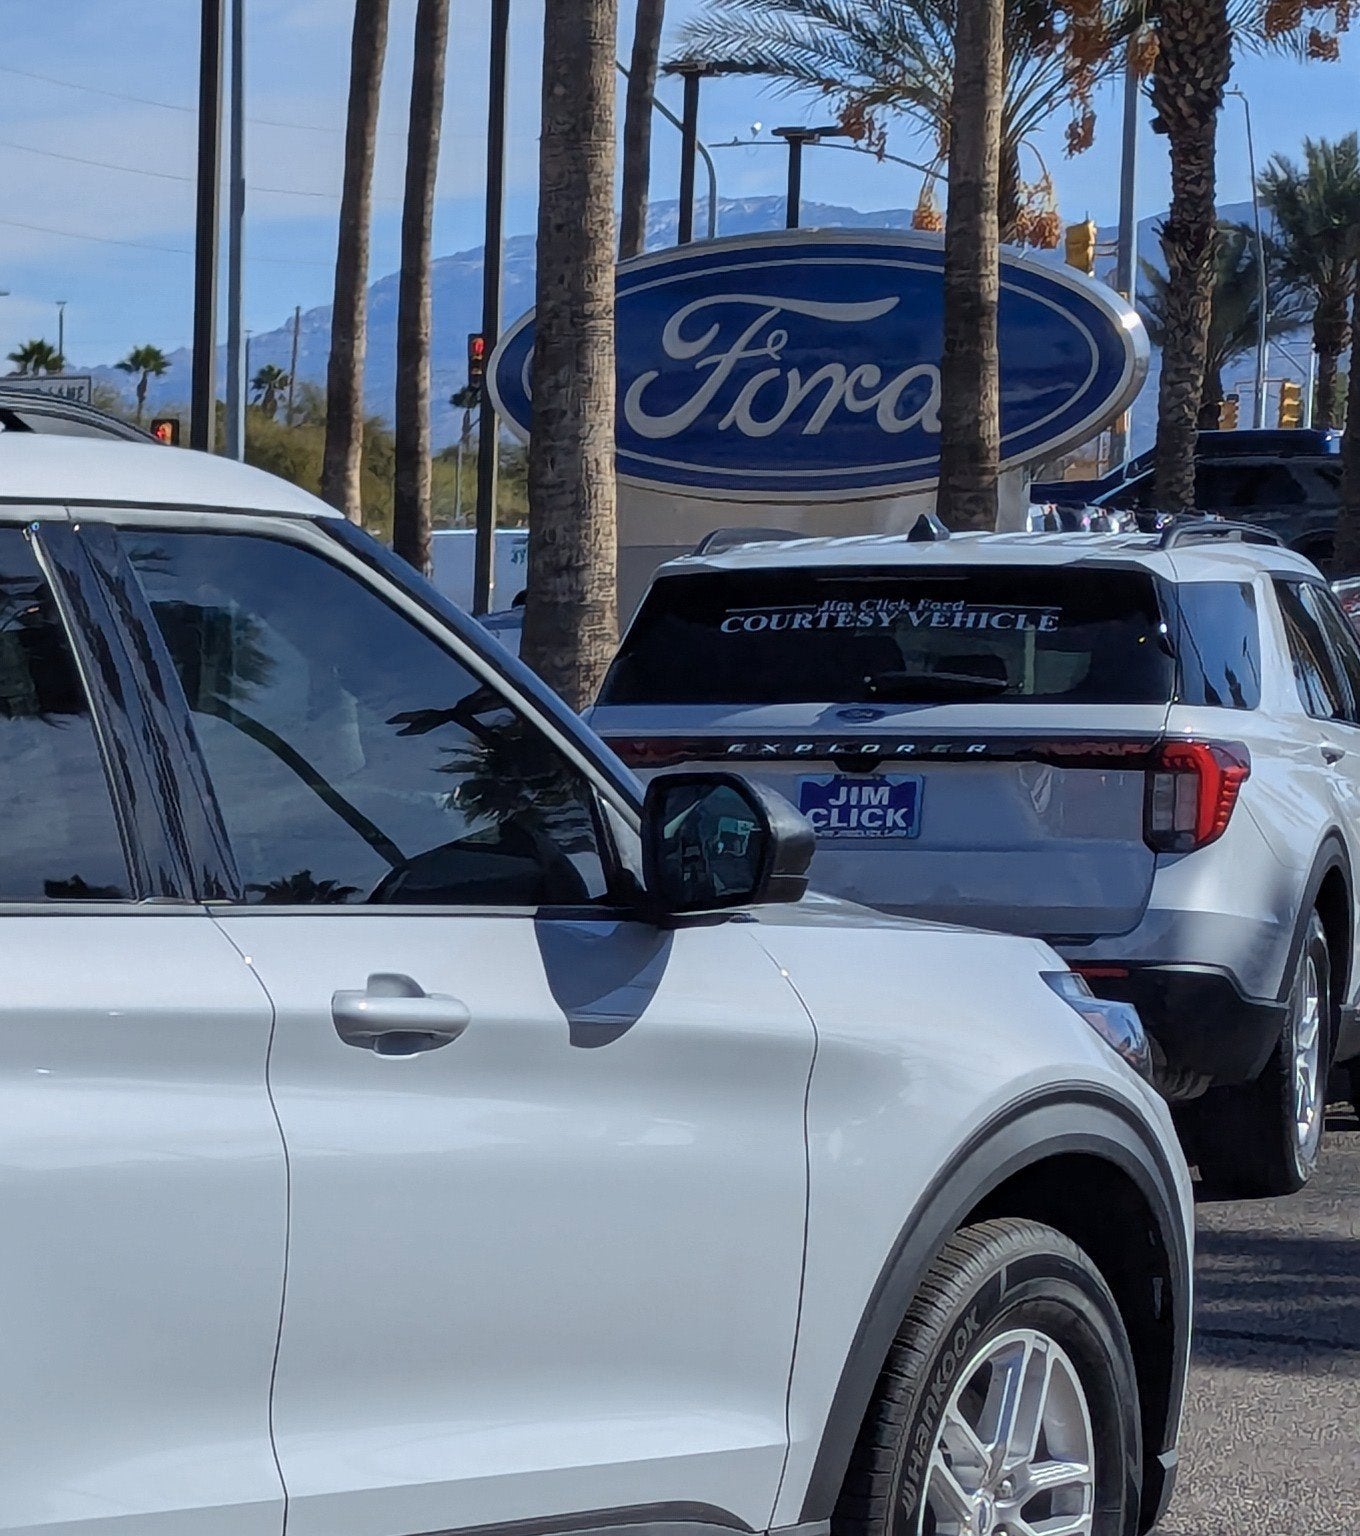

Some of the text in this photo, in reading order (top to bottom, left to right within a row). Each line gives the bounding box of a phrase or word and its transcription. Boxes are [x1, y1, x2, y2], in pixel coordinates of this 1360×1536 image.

[720, 610, 1060, 634] COURTESY VEHICLE
[727, 743, 986, 753] EXPLORER
[828, 786, 891, 806] JIM
[806, 808, 909, 828] CLICK
